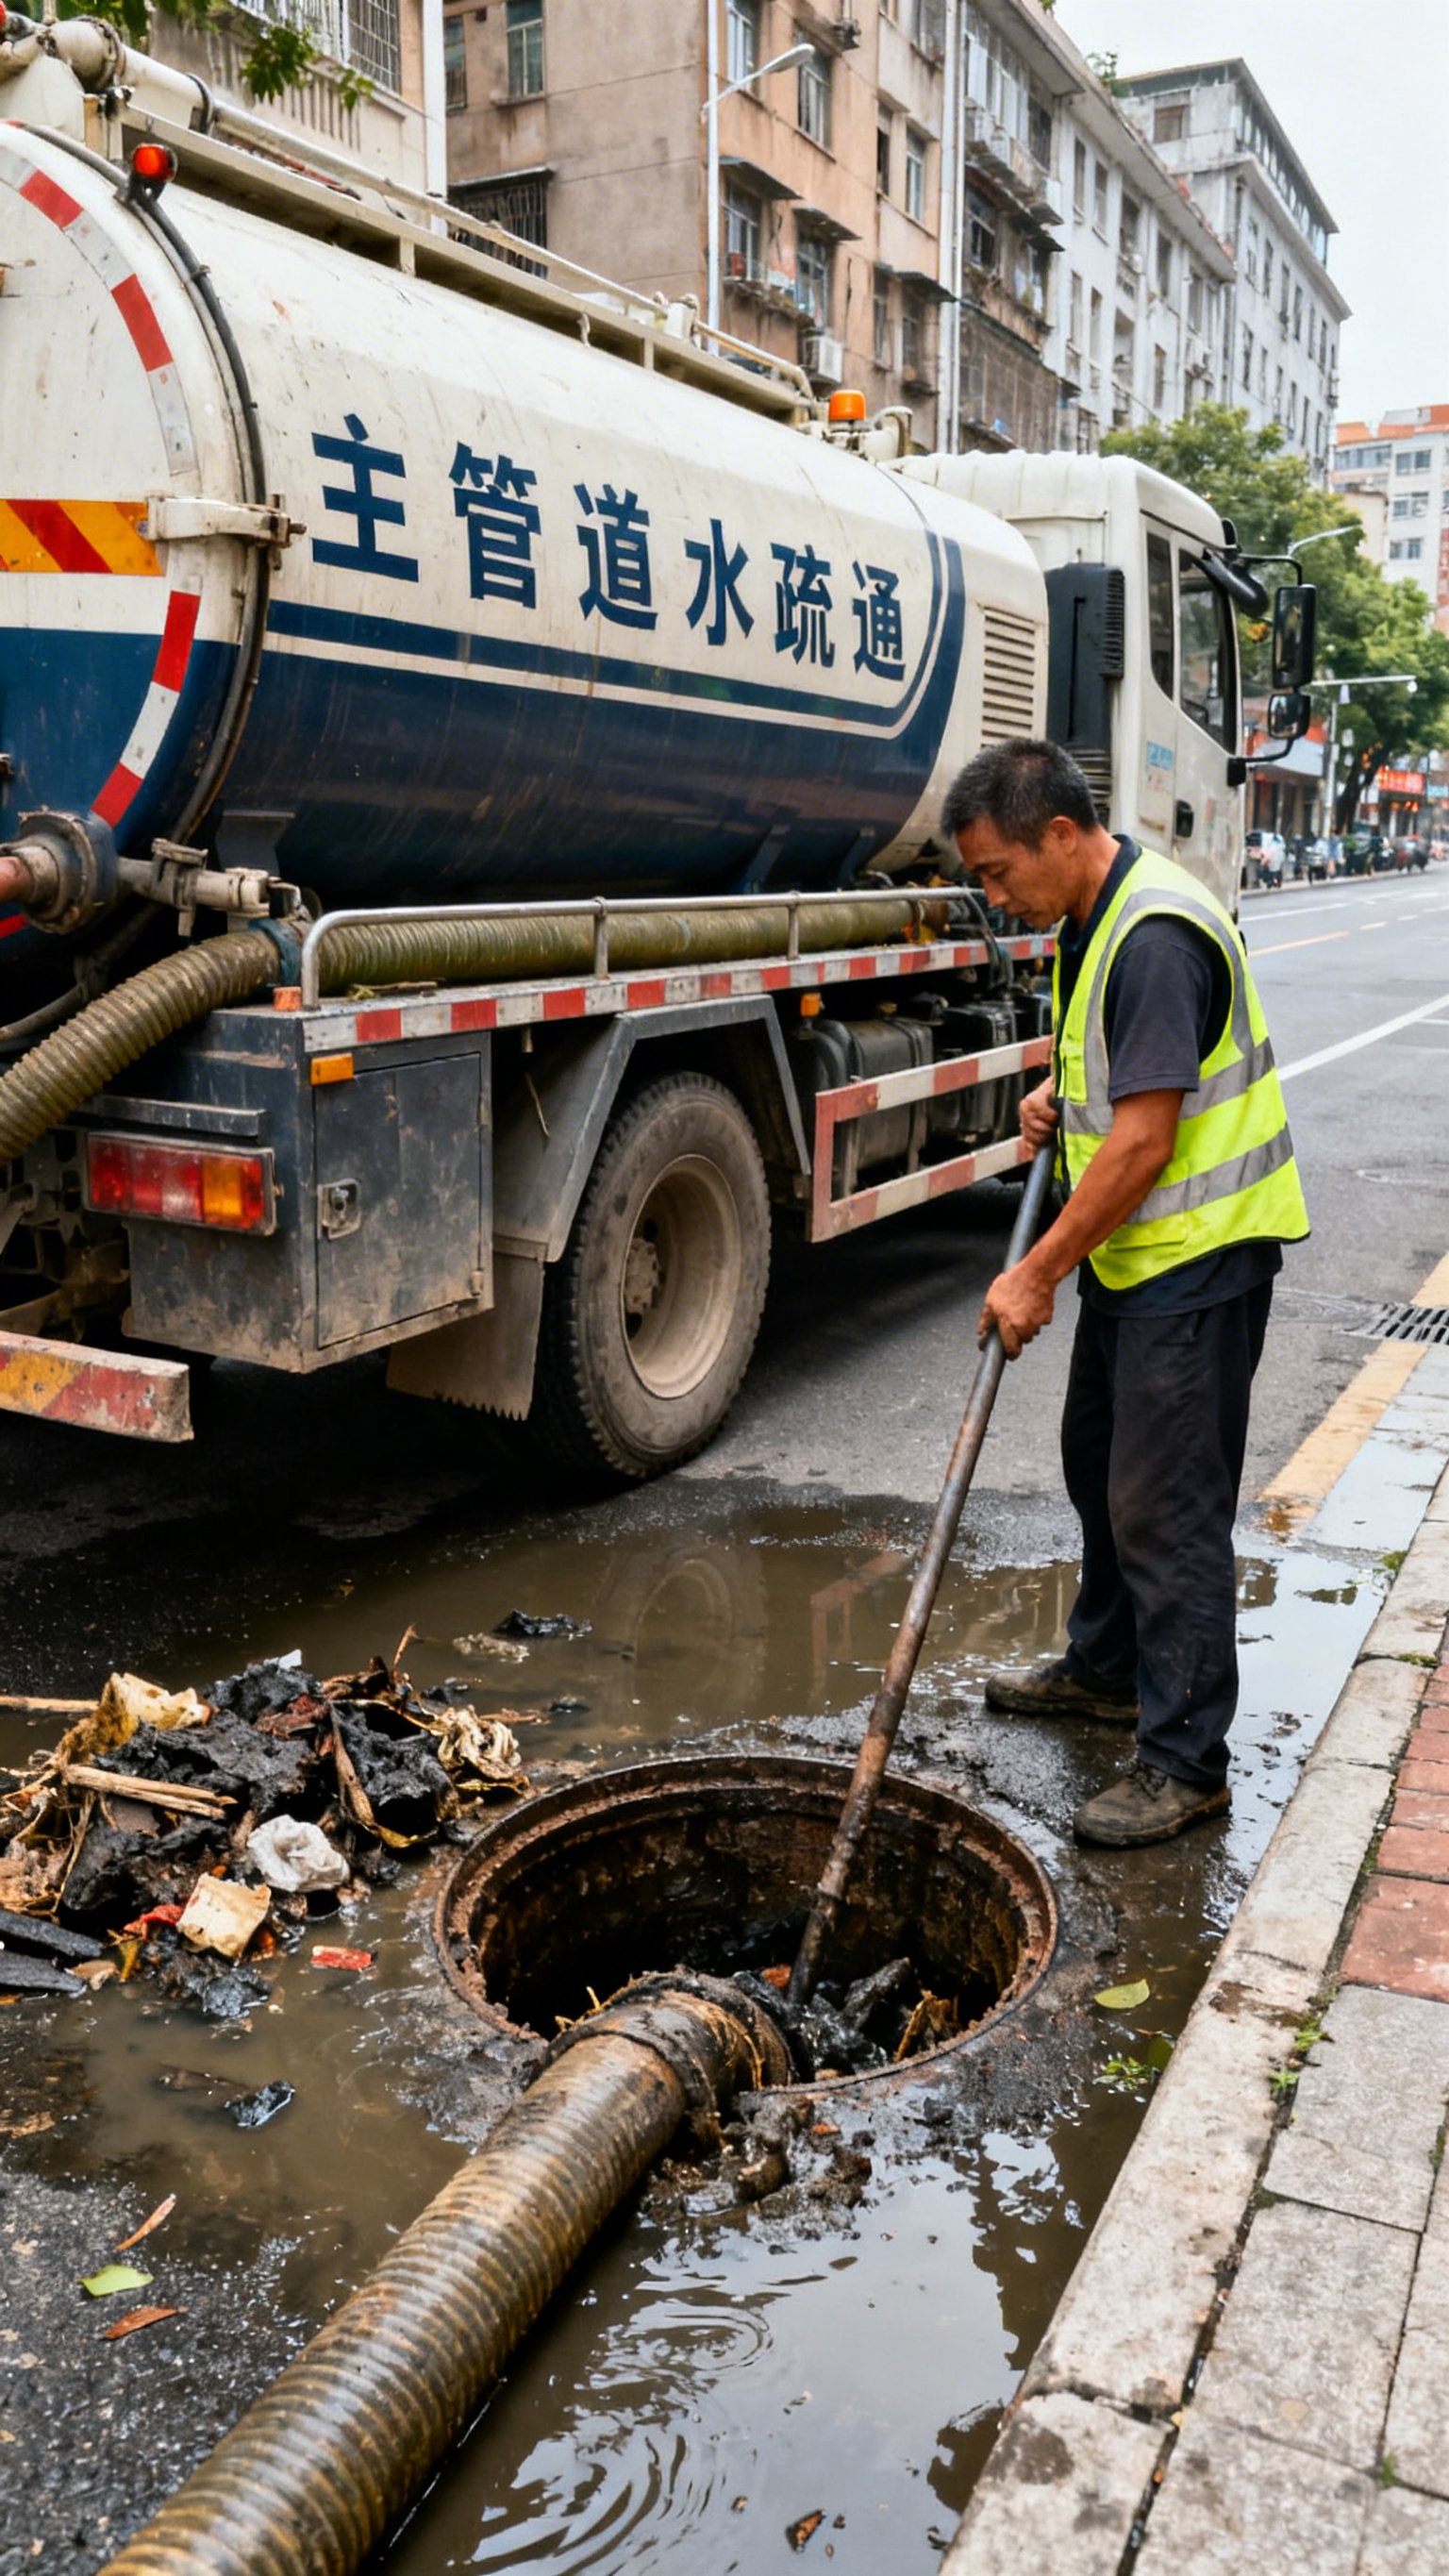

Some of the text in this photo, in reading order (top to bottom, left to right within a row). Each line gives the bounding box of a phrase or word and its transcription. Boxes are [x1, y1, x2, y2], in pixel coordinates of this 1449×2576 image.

[311, 413, 907, 681] 主管道水疏通
